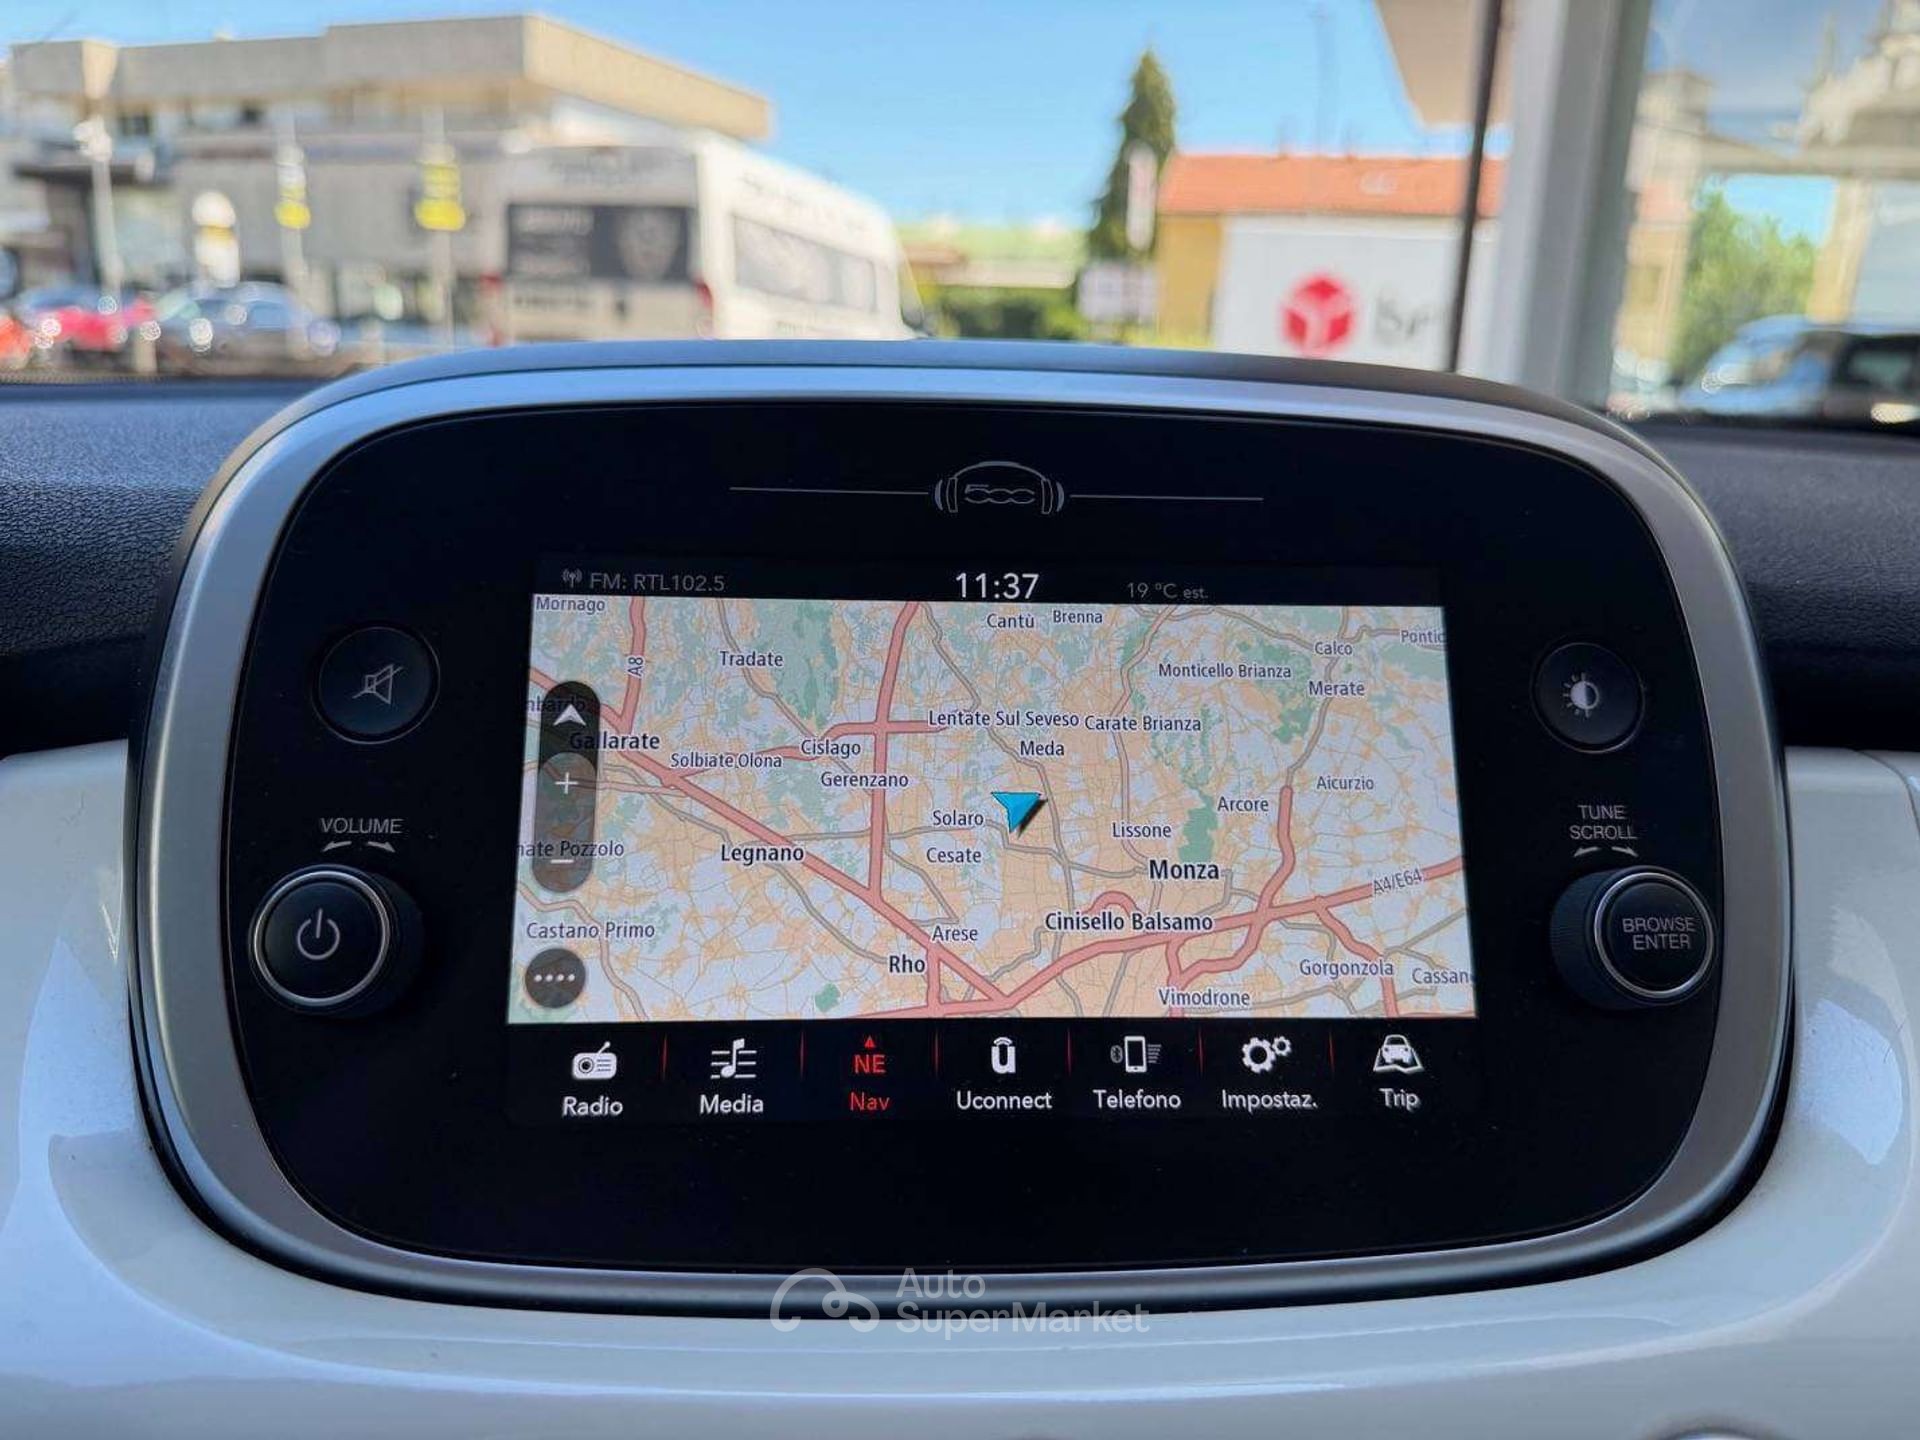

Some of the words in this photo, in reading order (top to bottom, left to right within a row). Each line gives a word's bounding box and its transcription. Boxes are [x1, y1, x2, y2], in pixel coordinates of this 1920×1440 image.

[589, 573, 627, 591] FM:
[633, 574, 726, 592] RTL102.5
[954, 572, 1040, 600] 11:37
[1127, 582, 1149, 598] 19
[535, 596, 606, 612] Mornago
[986, 612, 1035, 629] Cantù
[1052, 610, 1103, 625] Brenna
[1314, 641, 1353, 656] Calco
[628, 655, 645, 678] A8
[719, 651, 784, 668] Tradate
[1158, 663, 1234, 679] Monticello
[1238, 663, 1292, 679] Brianza
[1308, 681, 1365, 697] Merate
[928, 710, 991, 727] Lentate
[996, 711, 1021, 727] Sul
[1025, 712, 1080, 727] Seveso
[1084, 715, 1138, 731] Carate
[1142, 716, 1202, 732] Brianza
[569, 731, 661, 750] Gallarate
[800, 738, 861, 756] Cislago
[1019, 740, 1065, 757] Meda
[670, 751, 735, 768] Solbiate
[738, 752, 783, 768] Olona
[820, 771, 909, 788] Gerenzano
[1316, 775, 1374, 790] Aicurzio
[1217, 797, 1269, 812] Arcore
[1577, 804, 1627, 820] TUNE
[320, 817, 404, 834] VOLUME
[932, 810, 984, 827] Solaro
[1112, 822, 1172, 838] Lissone
[1569, 824, 1638, 840] SCROLL
[559, 840, 625, 857] Pozzolo
[720, 843, 805, 864] Legnano
[926, 848, 982, 864] Cesate
[1148, 859, 1220, 881] Monza
[1372, 867, 1424, 895] A4/E64
[1045, 911, 1125, 931] Cinisello
[1131, 912, 1214, 931] Balsamo
[1622, 916, 1697, 933] BROWSE
[526, 922, 599, 939] Castano
[604, 922, 656, 939] Primo
[932, 926, 979, 942] Arese
[1632, 934, 1691, 950] ENTER
[888, 955, 926, 974] Rho
[1299, 959, 1395, 980] Gorgonzola
[1158, 988, 1251, 1007] Vimodrone
[854, 1053, 886, 1074] NE
[562, 1095, 624, 1117] Radio
[699, 1094, 764, 1114] Media
[850, 1092, 891, 1111] Nav
[956, 1090, 1053, 1110] Uconnect
[1094, 1088, 1182, 1110] Telefono
[1221, 1088, 1319, 1112] Impostaz.
[1379, 1087, 1420, 1110] Trip
